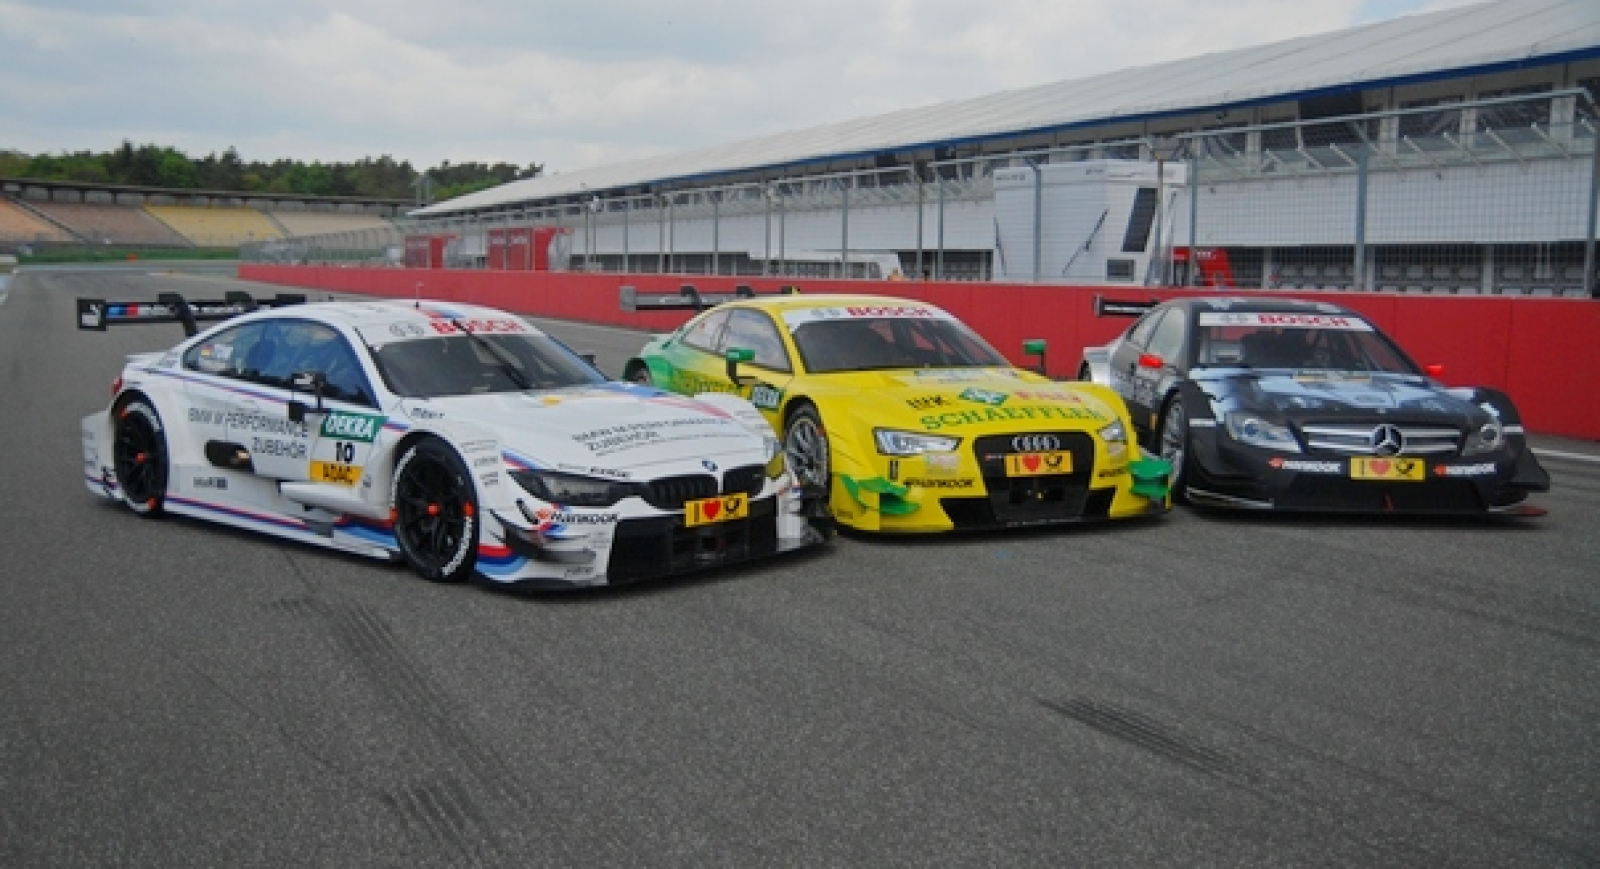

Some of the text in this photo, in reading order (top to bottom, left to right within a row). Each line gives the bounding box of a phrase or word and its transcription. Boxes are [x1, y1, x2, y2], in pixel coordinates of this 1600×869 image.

[1258, 314, 1351, 327] BOSCH
[325, 414, 374, 438] DEKRA
[921, 405, 1107, 430] SCHAEFFLER
[335, 442, 354, 463] 10
